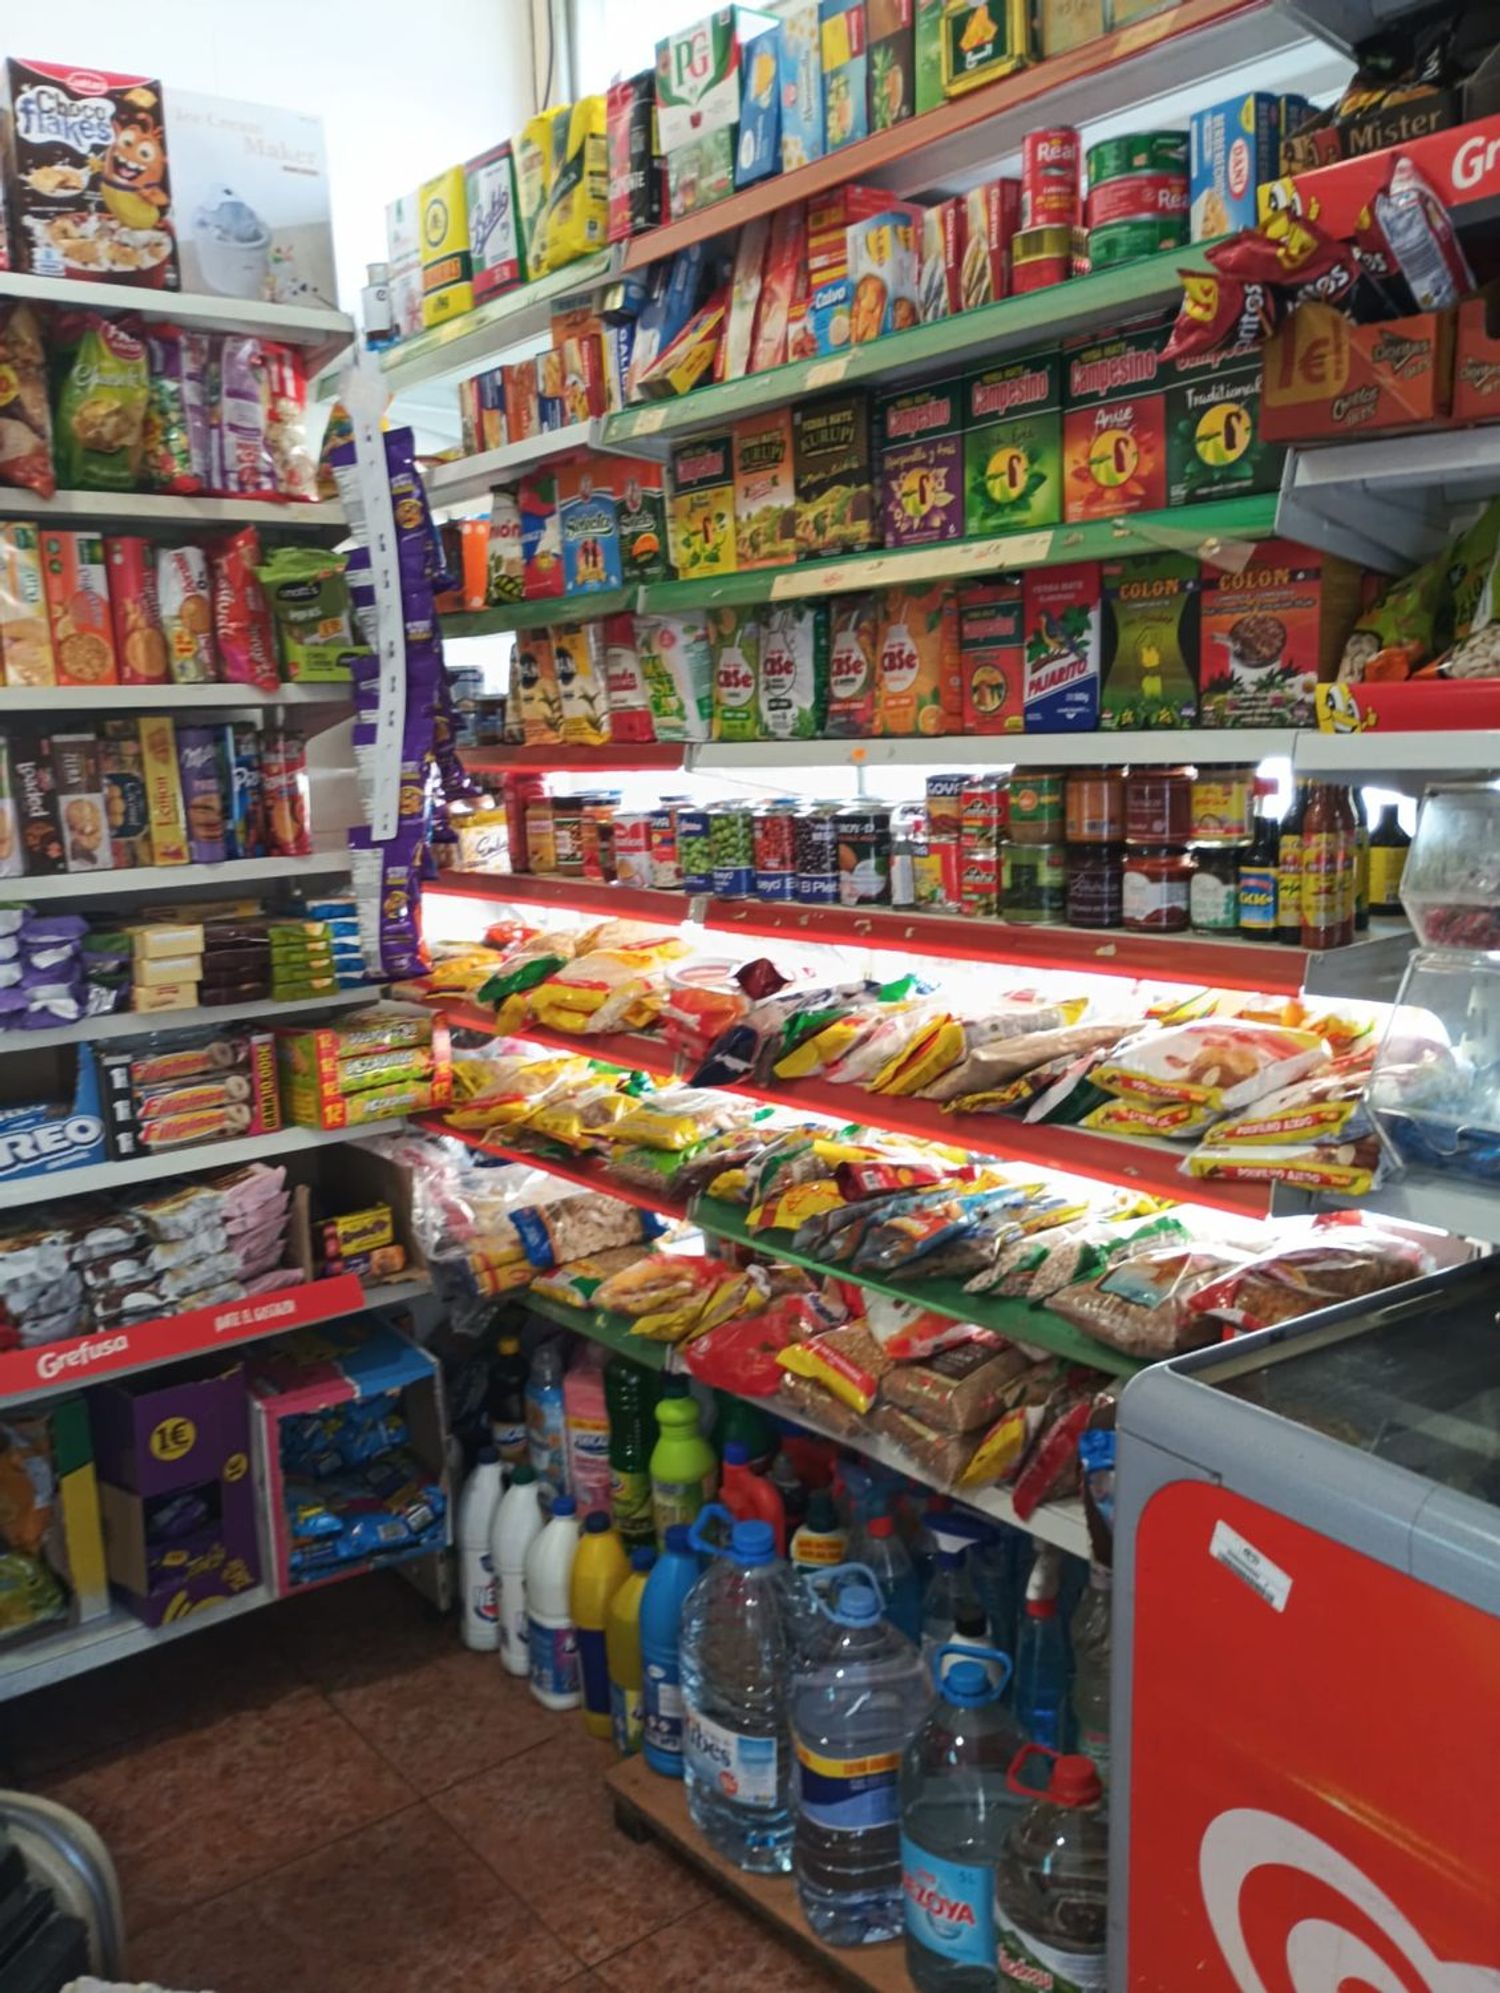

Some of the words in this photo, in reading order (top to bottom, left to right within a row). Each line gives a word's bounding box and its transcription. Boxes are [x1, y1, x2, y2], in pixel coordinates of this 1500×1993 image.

[675, 31, 708, 87] PG
[18, 97, 112, 142] flakes
[36, 90, 107, 120] Choco
[1349, 109, 1441, 154] Mister
[1232, 146, 1246, 190] DANI
[1157, 187, 1191, 210] Rea
[814, 285, 848, 309] Calvo
[972, 370, 1050, 419] Campesino
[1070, 348, 1157, 397] Campesino
[801, 424, 856, 450] KURUPI
[1119, 578, 1180, 600] COLON
[1028, 661, 1088, 694] PAJARITO
[0, 1120, 102, 1169] REO
[37, 1334, 128, 1378] Grefusa
[159, 1427, 188, 1451] 1€
